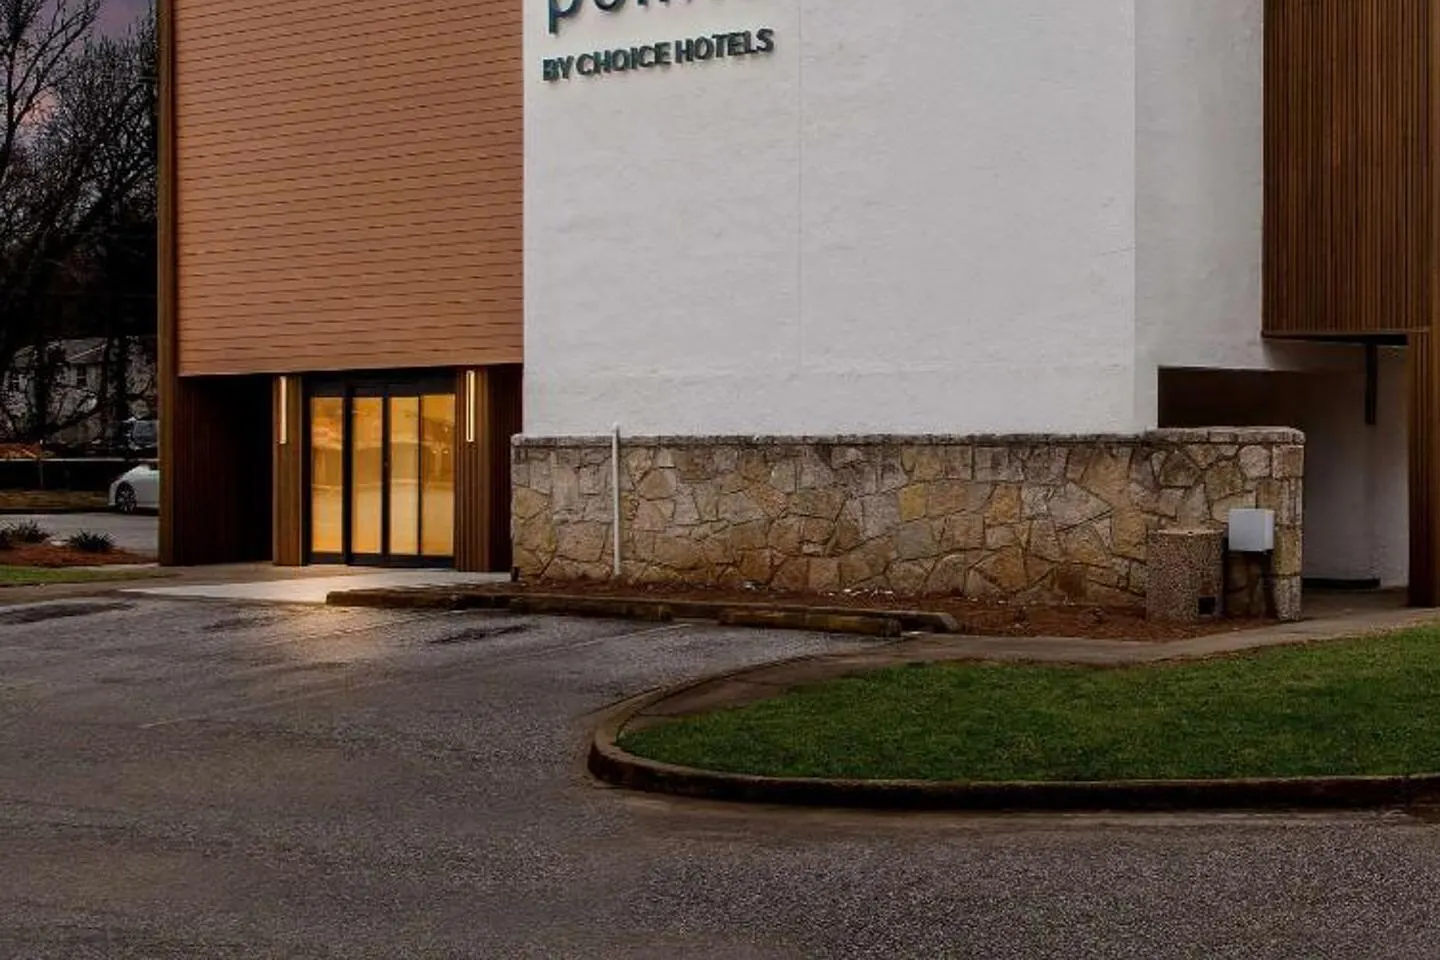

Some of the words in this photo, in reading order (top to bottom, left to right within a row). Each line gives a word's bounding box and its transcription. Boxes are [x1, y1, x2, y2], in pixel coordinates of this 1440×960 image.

[542, 56, 573, 82] BY
[576, 41, 671, 77] CHOICE
[675, 28, 774, 63] HOTELS
